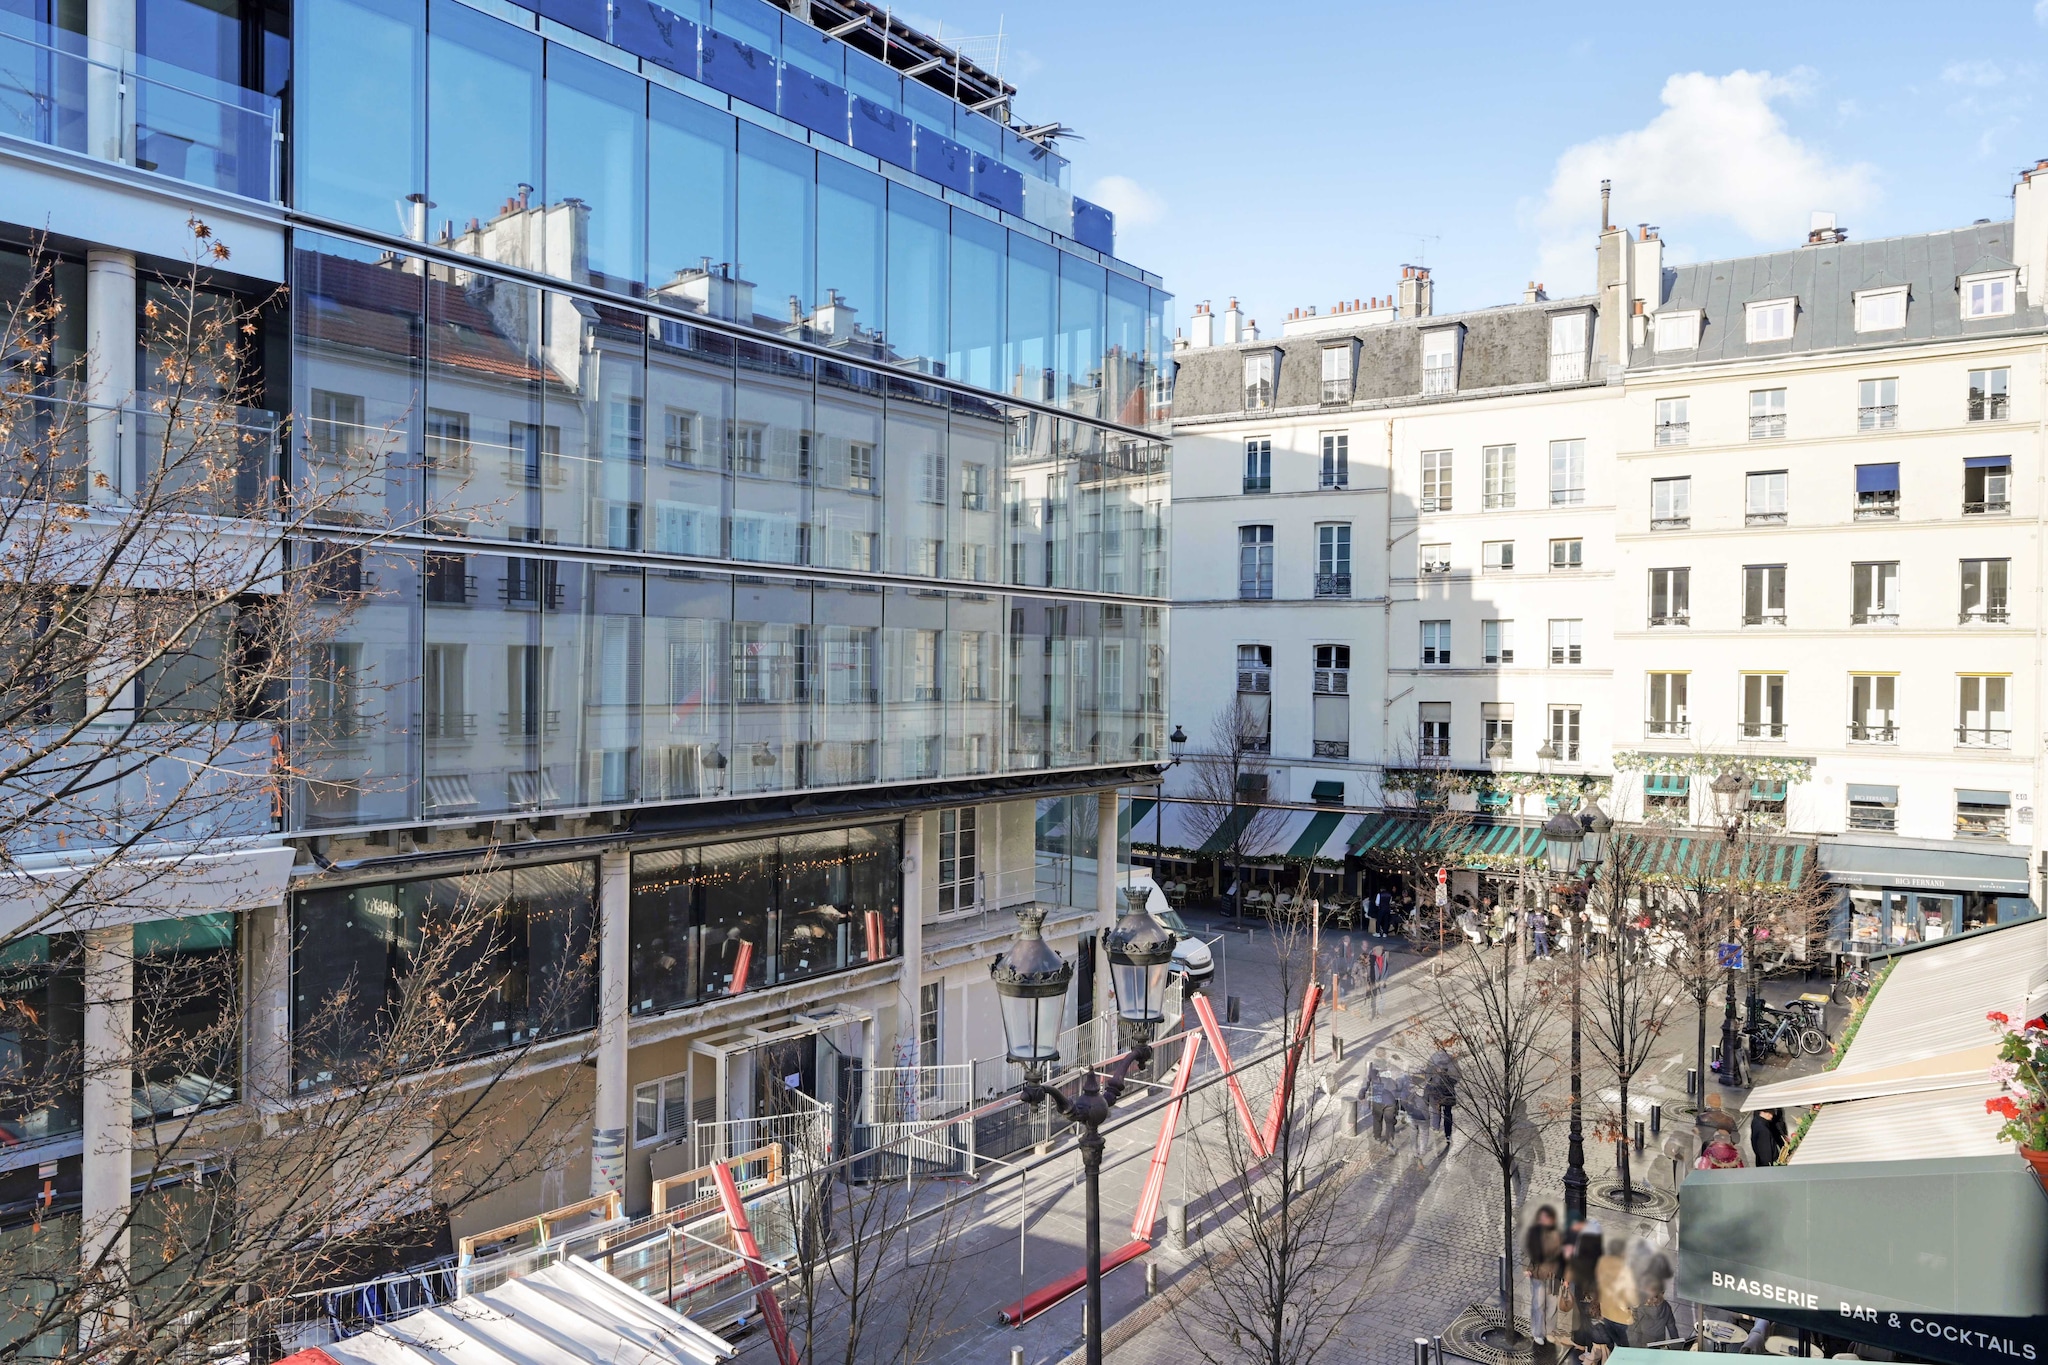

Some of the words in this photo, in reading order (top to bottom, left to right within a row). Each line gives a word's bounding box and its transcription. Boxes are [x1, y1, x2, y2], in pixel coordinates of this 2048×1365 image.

[1895, 878, 1910, 886] BIG
[1912, 878, 1945, 888] FERNAND
[1712, 1271, 1819, 1310] BRASSERIE
[1840, 1301, 1878, 1324] BAR
[1887, 1312, 1901, 1328] &
[1910, 1318, 2037, 1360] COCKTAILS
